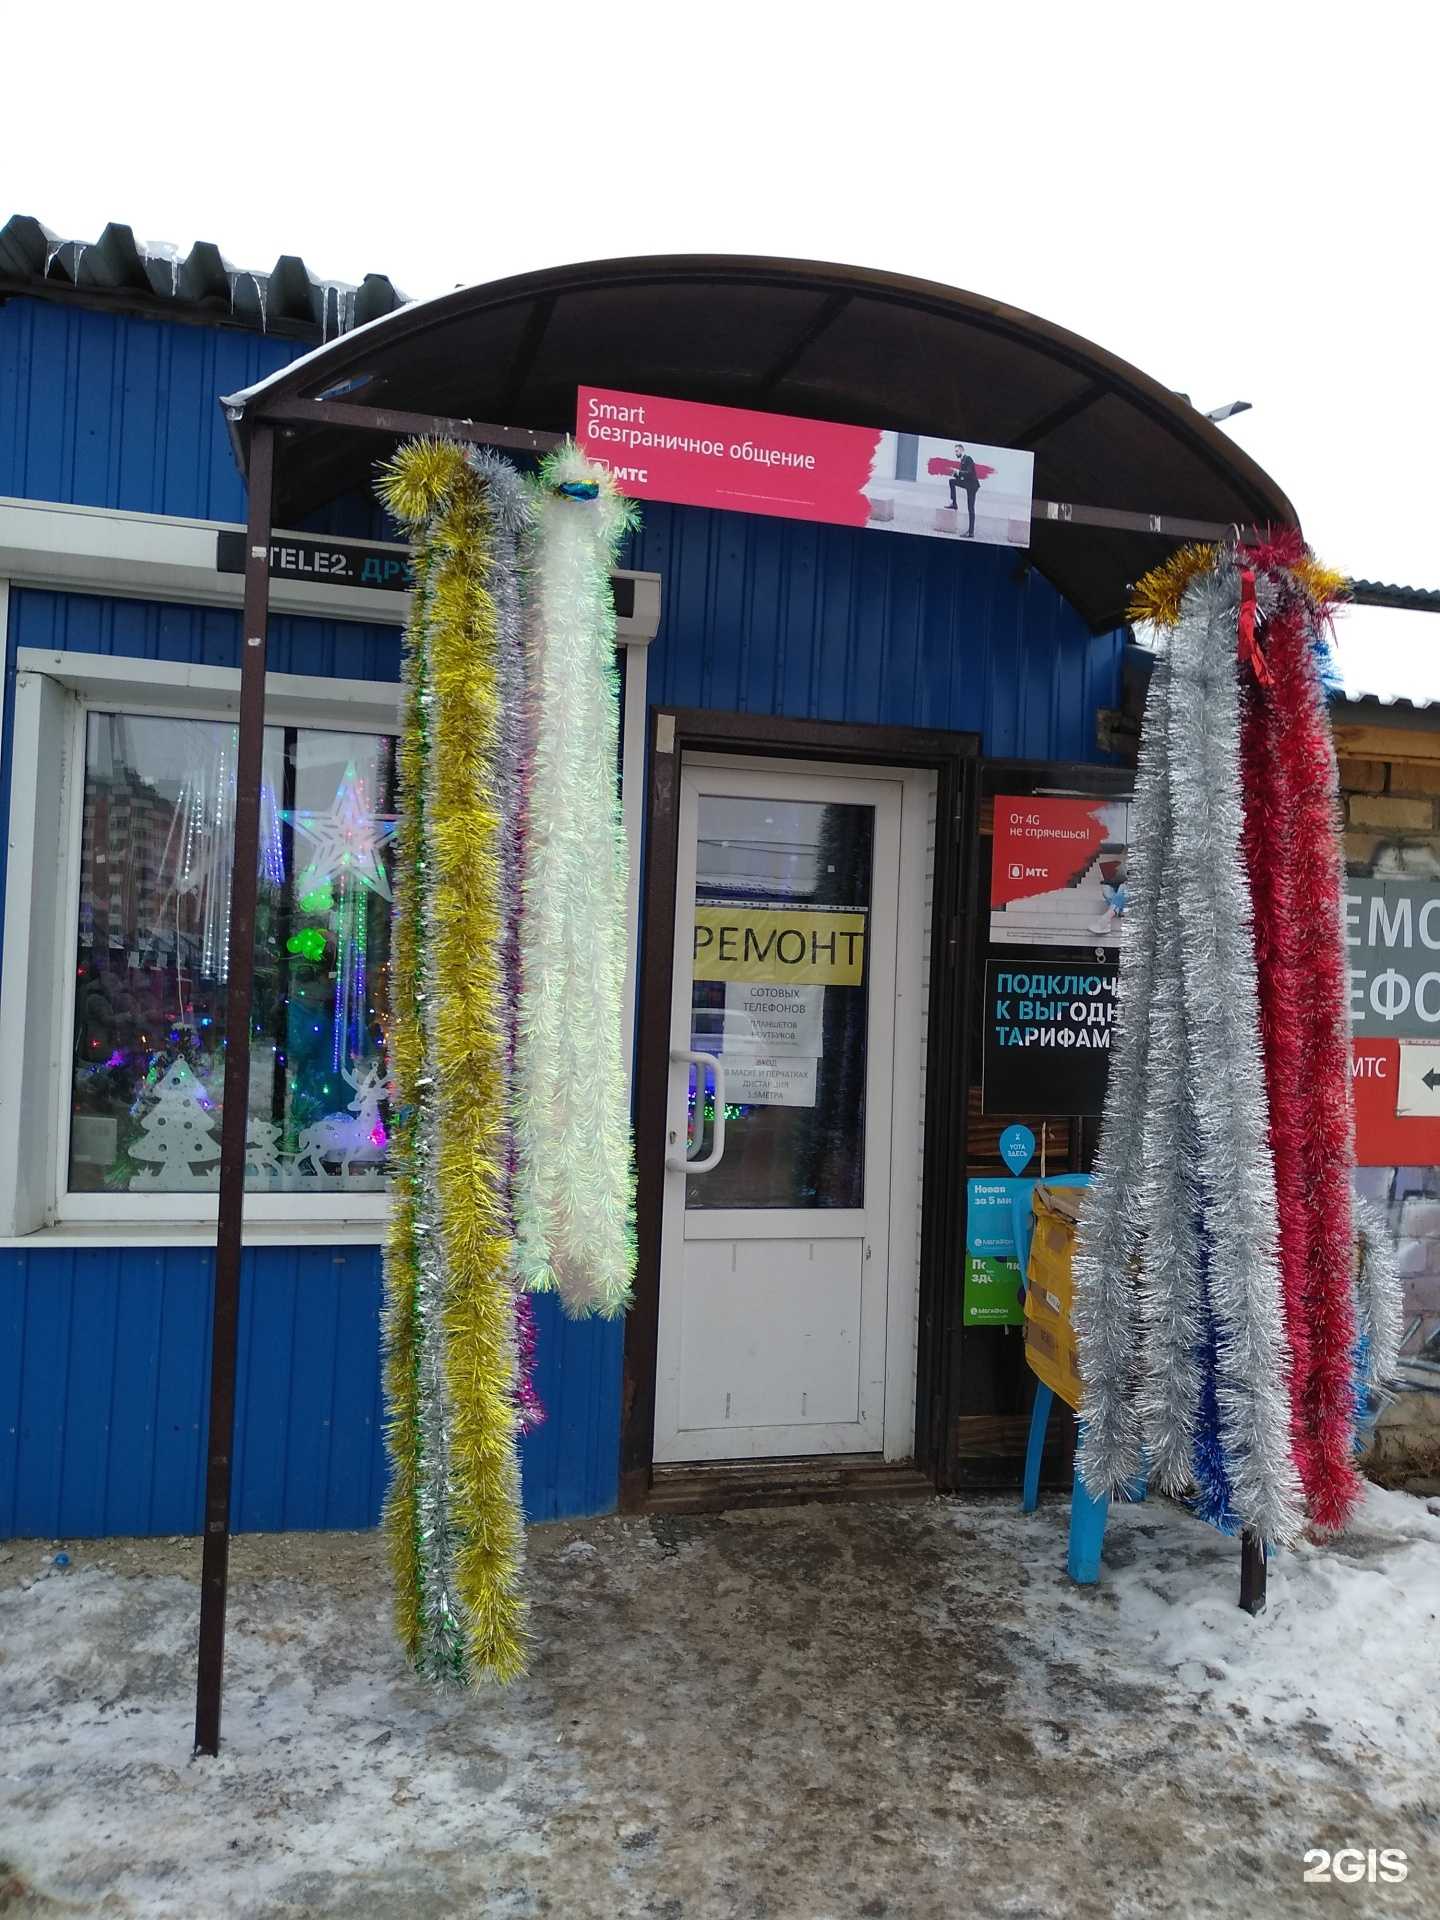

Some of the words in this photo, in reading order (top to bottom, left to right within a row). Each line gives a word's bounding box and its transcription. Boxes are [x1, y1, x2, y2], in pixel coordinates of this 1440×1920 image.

[588, 398, 645, 424] Smart
[587, 419, 724, 457] безграничное
[729, 441, 816, 470] общение
[1010, 813, 1024, 825] От
[1026, 813, 1040, 826] 4G
[1010, 827, 1023, 836] не
[1025, 827, 1090, 840] спрячешься!
[693, 925, 864, 966] РЕМОНТ
[750, 987, 800, 999] СОТОВЫХ
[743, 1002, 806, 1014] ТЕЛЕФОНОВ
[996, 1000, 1011, 1020] К
[995, 1026, 1111, 1048] ТАРИФАМ
[1009, 1143, 1026, 1151] YOTA
[988, 1196, 996, 1205] 5
